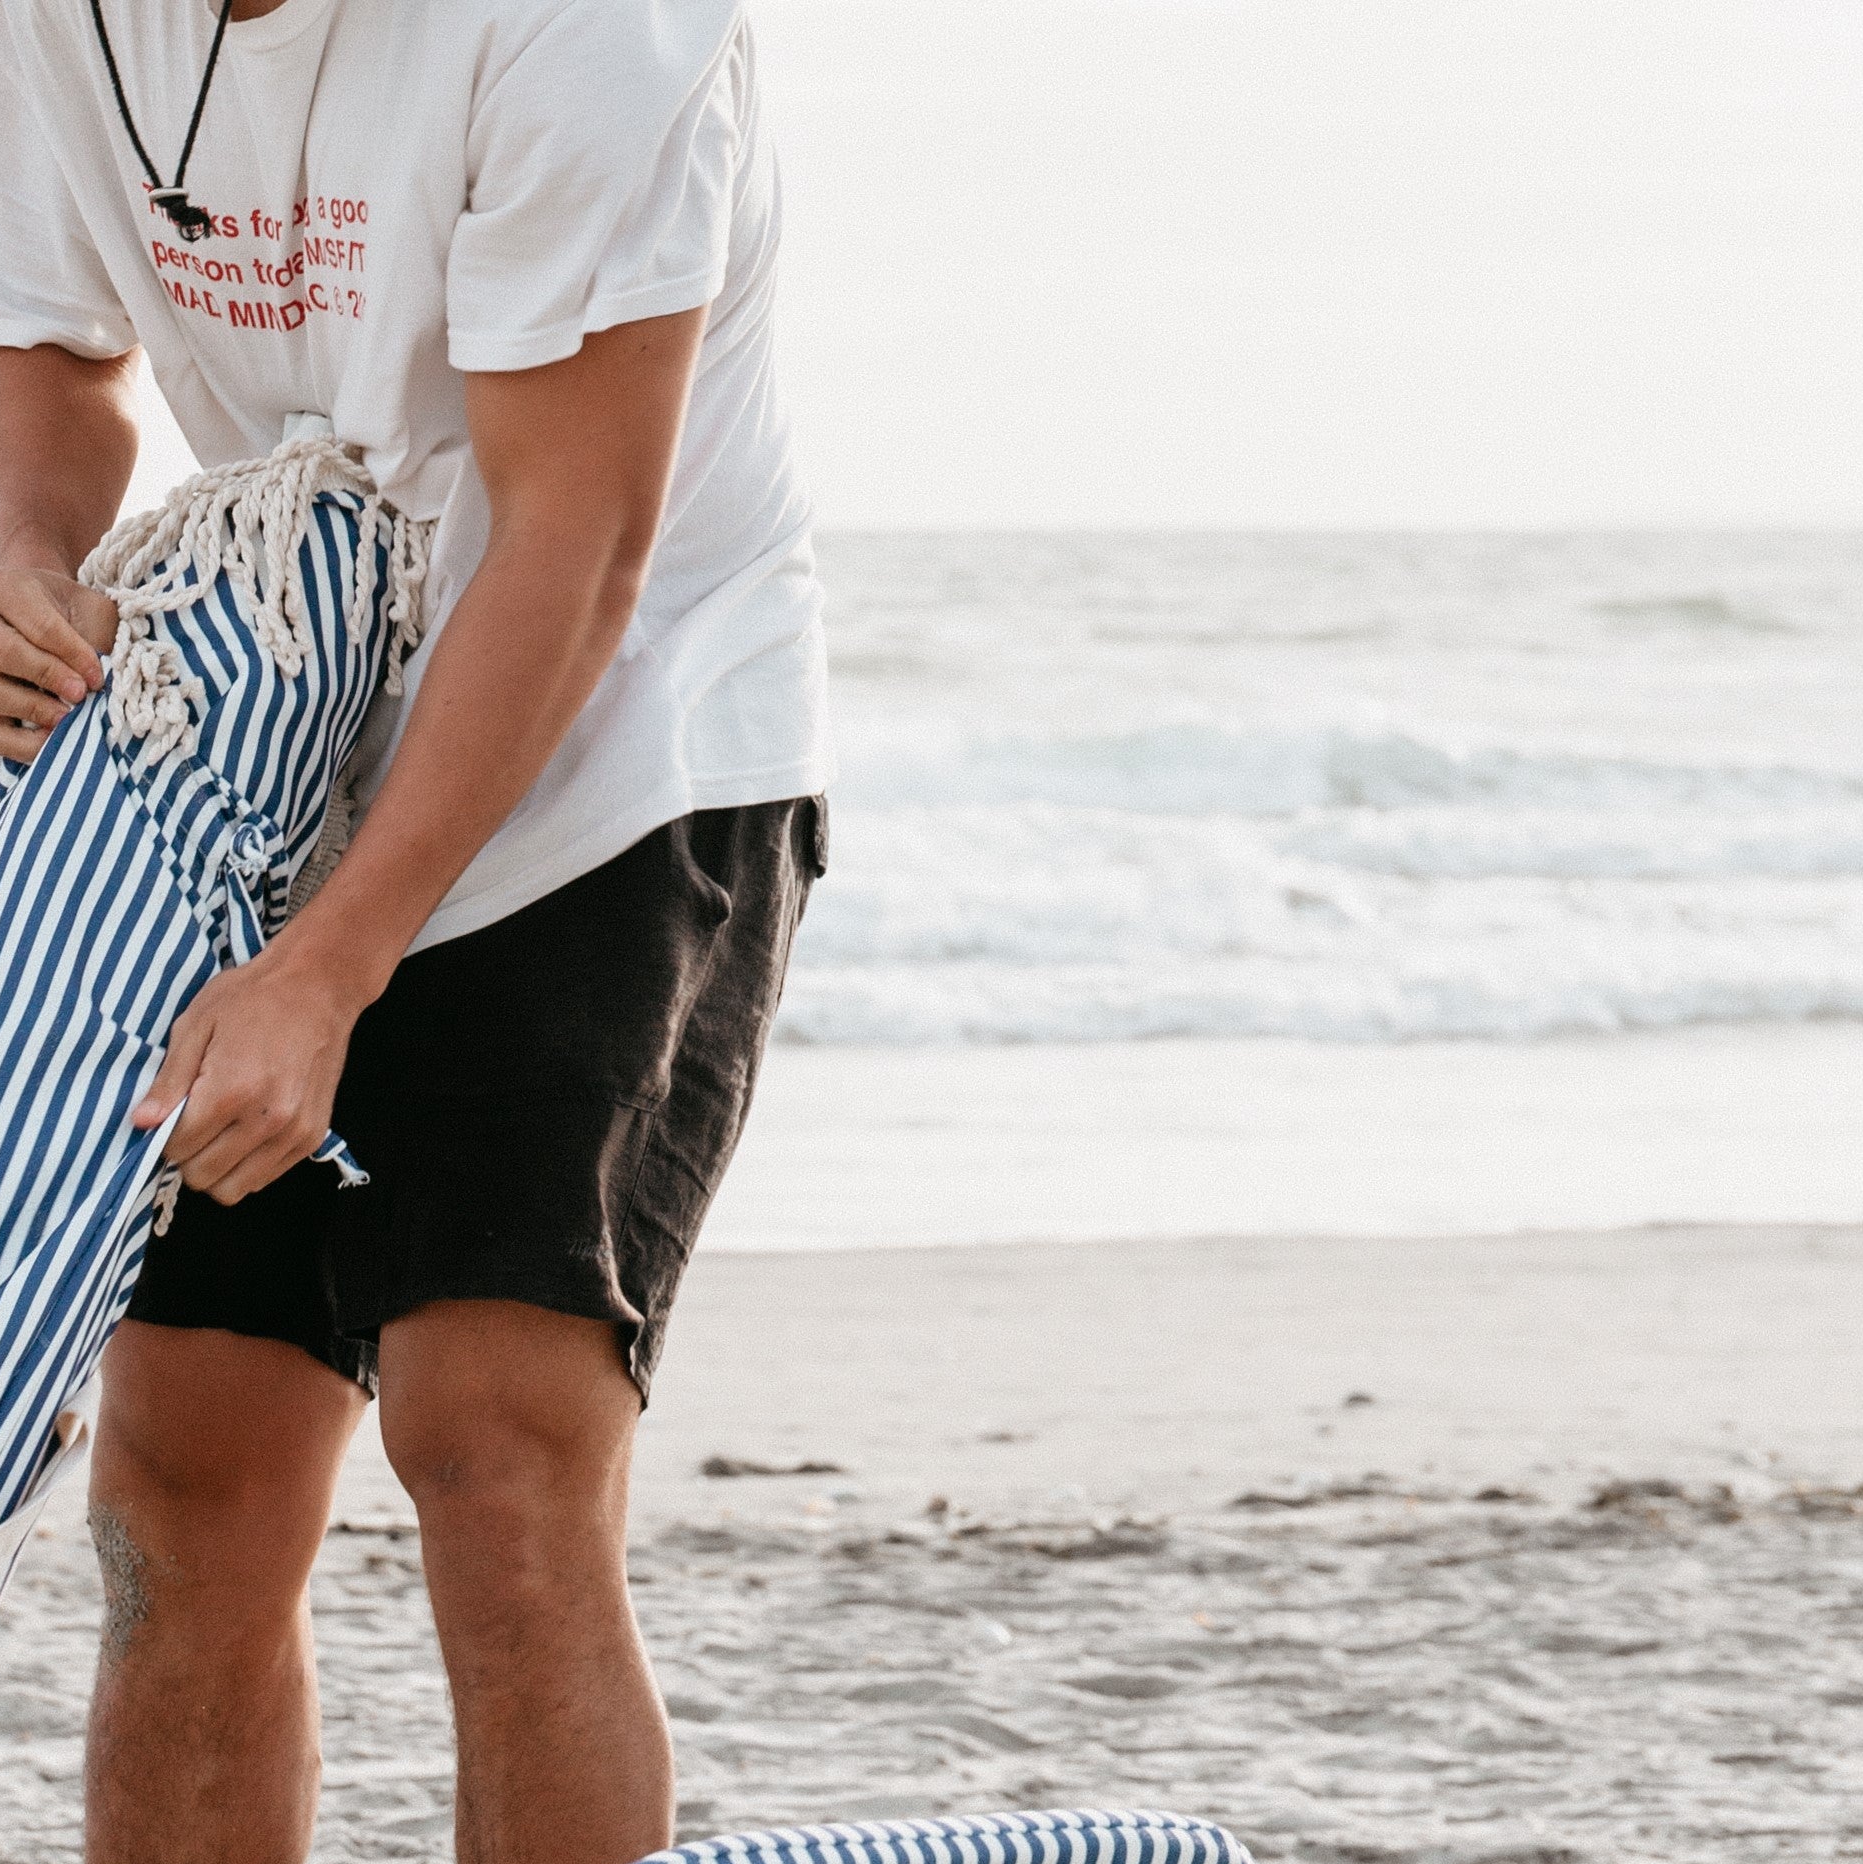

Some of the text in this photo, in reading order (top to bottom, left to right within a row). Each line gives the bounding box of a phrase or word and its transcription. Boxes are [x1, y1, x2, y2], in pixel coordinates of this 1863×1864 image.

[250, 209, 282, 241] for
[317, 196, 327, 219] a
[152, 240, 243, 284] person
[163, 278, 222, 318] MAD
[228, 299, 305, 332] MIND
